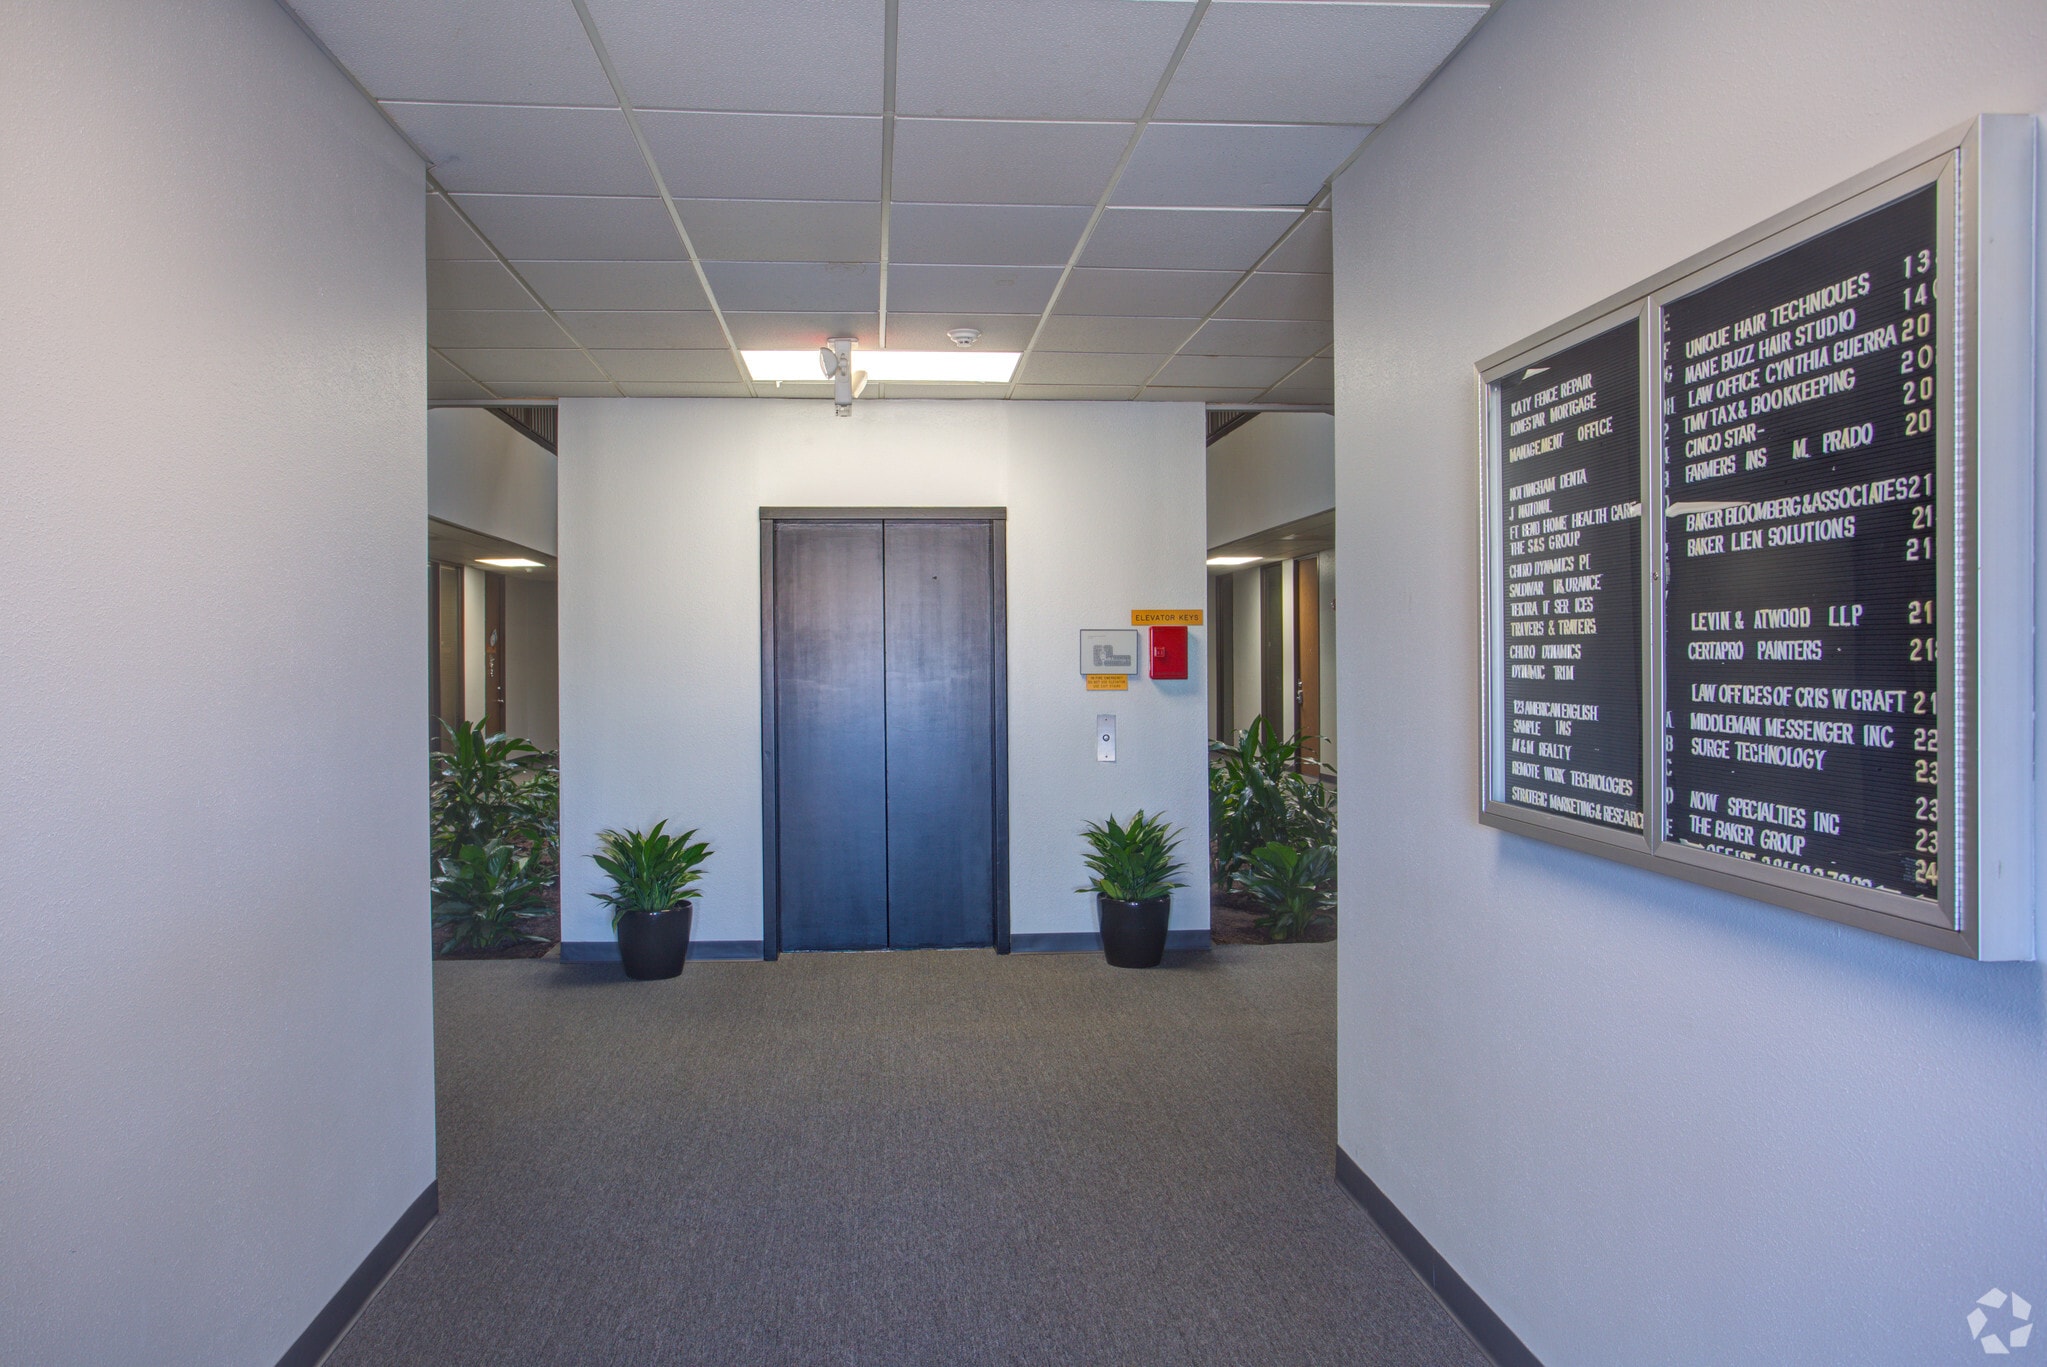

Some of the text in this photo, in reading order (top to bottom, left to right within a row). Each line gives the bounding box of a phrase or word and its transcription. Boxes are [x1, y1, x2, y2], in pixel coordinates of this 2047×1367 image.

[1685, 249, 1937, 359] UNIQUE HAIR TECHNIQUES 13
[1684, 359, 1719, 385] MANE
[1720, 346, 1755, 373] BUZZ
[1759, 335, 1791, 360] HAIR
[1795, 308, 1856, 347] STUDIO
[1689, 383, 1714, 408] LAW
[1716, 368, 1760, 397] OFFICE
[1765, 347, 1830, 384] CYNTHIA
[1833, 324, 1898, 363] GUERRA
[1511, 373, 1593, 417] KATY FENCE REPAIR
[1683, 411, 1709, 434] TMV
[1751, 369, 1855, 415] BOOKKEEPING
[1901, 344, 1937, 374] 20
[1511, 392, 1597, 436] LONESTAR MORTGAGE
[1685, 432, 1721, 459] CINCO
[1903, 376, 1934, 405] 20
[1510, 416, 1613, 463] MANAGEMENT OFFICE
[1685, 455, 1736, 483] FARMERS
[1746, 448, 1767, 470] INS
[1823, 423, 1873, 454] PRADO
[1905, 409, 1931, 436] 20
[1510, 468, 1588, 502] NOTTINGHAM DENTA
[1518, 498, 1553, 519] NATIONAL
[1543, 515, 1569, 533] HOME
[1572, 507, 1608, 528] HEALTH
[1686, 510, 1723, 532] BAKER
[1510, 530, 1581, 556] THE S&S GROUP
[1687, 535, 1724, 558] BAKER
[1731, 529, 1763, 552] LIEN
[1768, 516, 1856, 548] SOLUTIONS
[1912, 505, 1932, 530] 21
[1906, 537, 1931, 561] 21
[1534, 556, 1575, 576] DYNAMICS
[1511, 618, 1597, 637] TRAVERS & TRAVERS
[1691, 611, 1732, 631] LEVIN
[1734, 611, 1744, 629] &
[1754, 607, 1811, 630] ATWOOD
[1829, 604, 1863, 627] LLP
[1509, 644, 1582, 660] CHIRO DYNAMICS
[1688, 638, 1938, 662] CERTAPRO PAINTERS 21
[1511, 664, 1575, 681] DYNAMIC TRIM
[1692, 684, 1718, 703] LAW
[1719, 684, 1772, 707] OFFICES
[1773, 687, 1793, 707] OF
[1795, 687, 1829, 709] CRIS
[1832, 689, 1849, 710] W
[1851, 689, 1906, 713] CRAFT
[1555, 720, 1572, 736] INS
[1690, 712, 1761, 736] MIDDLEMAN
[1765, 716, 1854, 745] MESSENGER
[1864, 724, 1894, 748] INC
[1539, 741, 1572, 760] REALTY
[1691, 738, 1730, 759] SURGE
[1735, 741, 1826, 770] TECHNOLOGY
[1512, 761, 1634, 797] REMOTE WORK TECHNOLOGIES
[1512, 786, 1548, 808] STRATEGIC
[1690, 791, 1719, 812] NOW
[1728, 797, 1806, 829] SPECIALTIES
[1814, 811, 1840, 836] INC
[1689, 814, 1712, 837] THE
[1714, 820, 1755, 846] BAKER
[1760, 829, 1806, 856] GROUP
